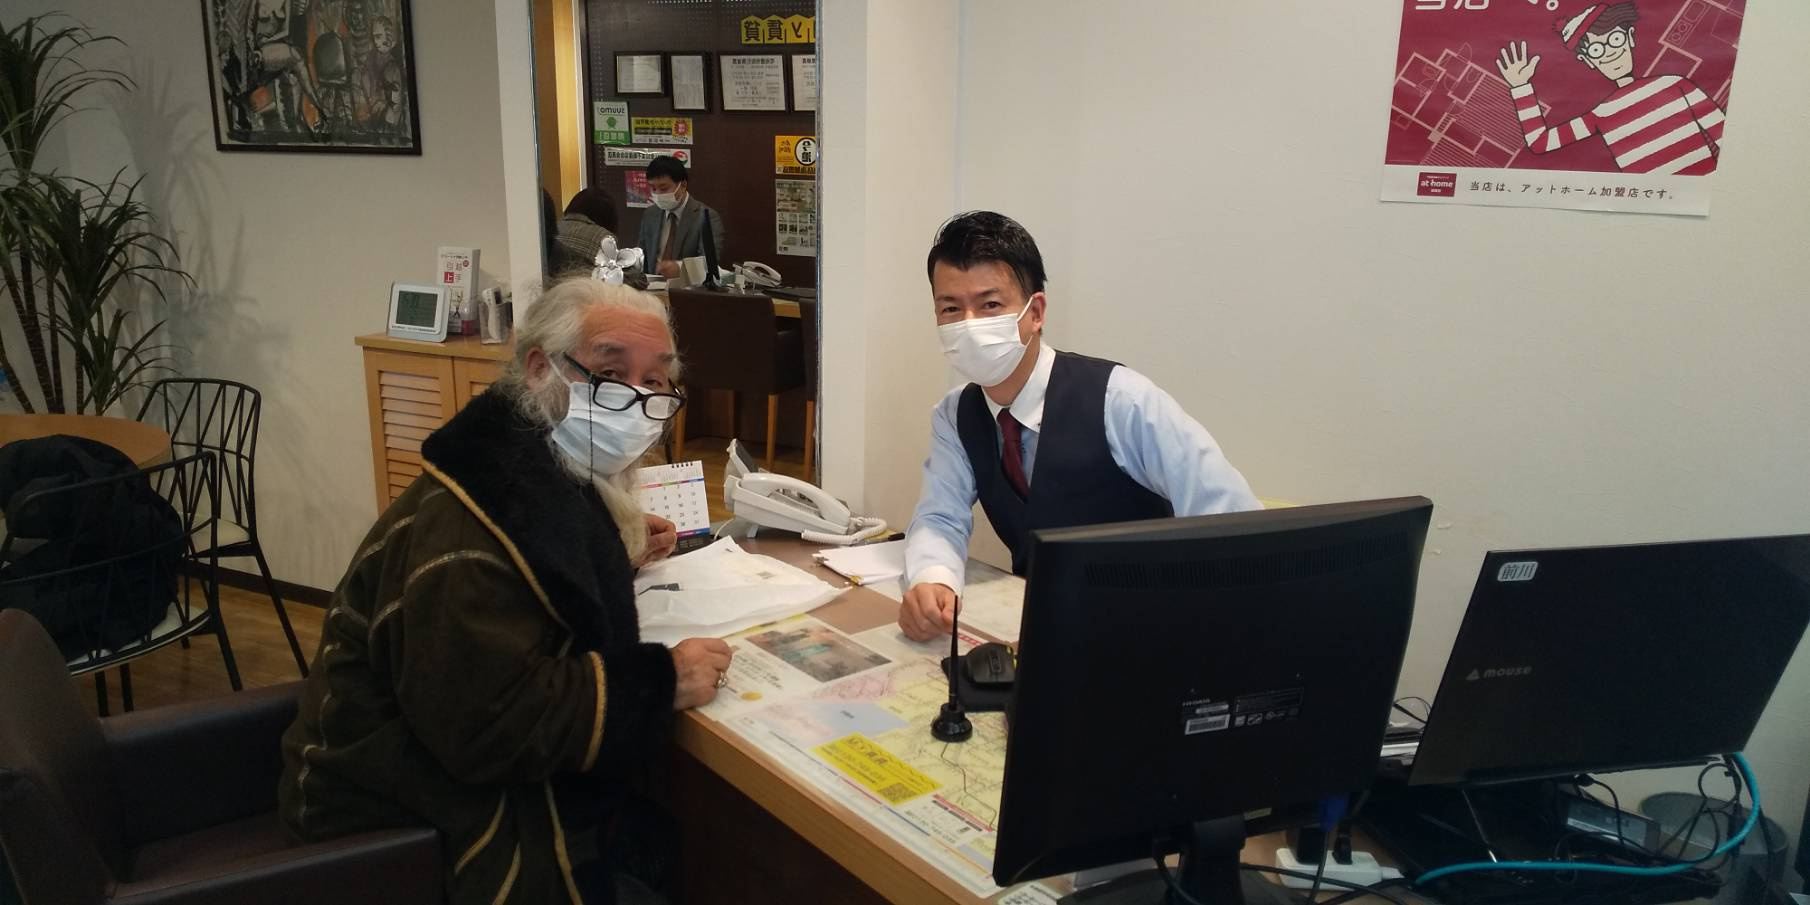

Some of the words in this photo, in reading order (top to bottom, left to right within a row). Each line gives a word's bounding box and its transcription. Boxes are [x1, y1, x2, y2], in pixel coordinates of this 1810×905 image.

[1469, 181, 1674, 200] 当店は、アットホーム加盟店です。
[1502, 564, 1535, 579] 前川
[1483, 666, 1532, 678] mouse
